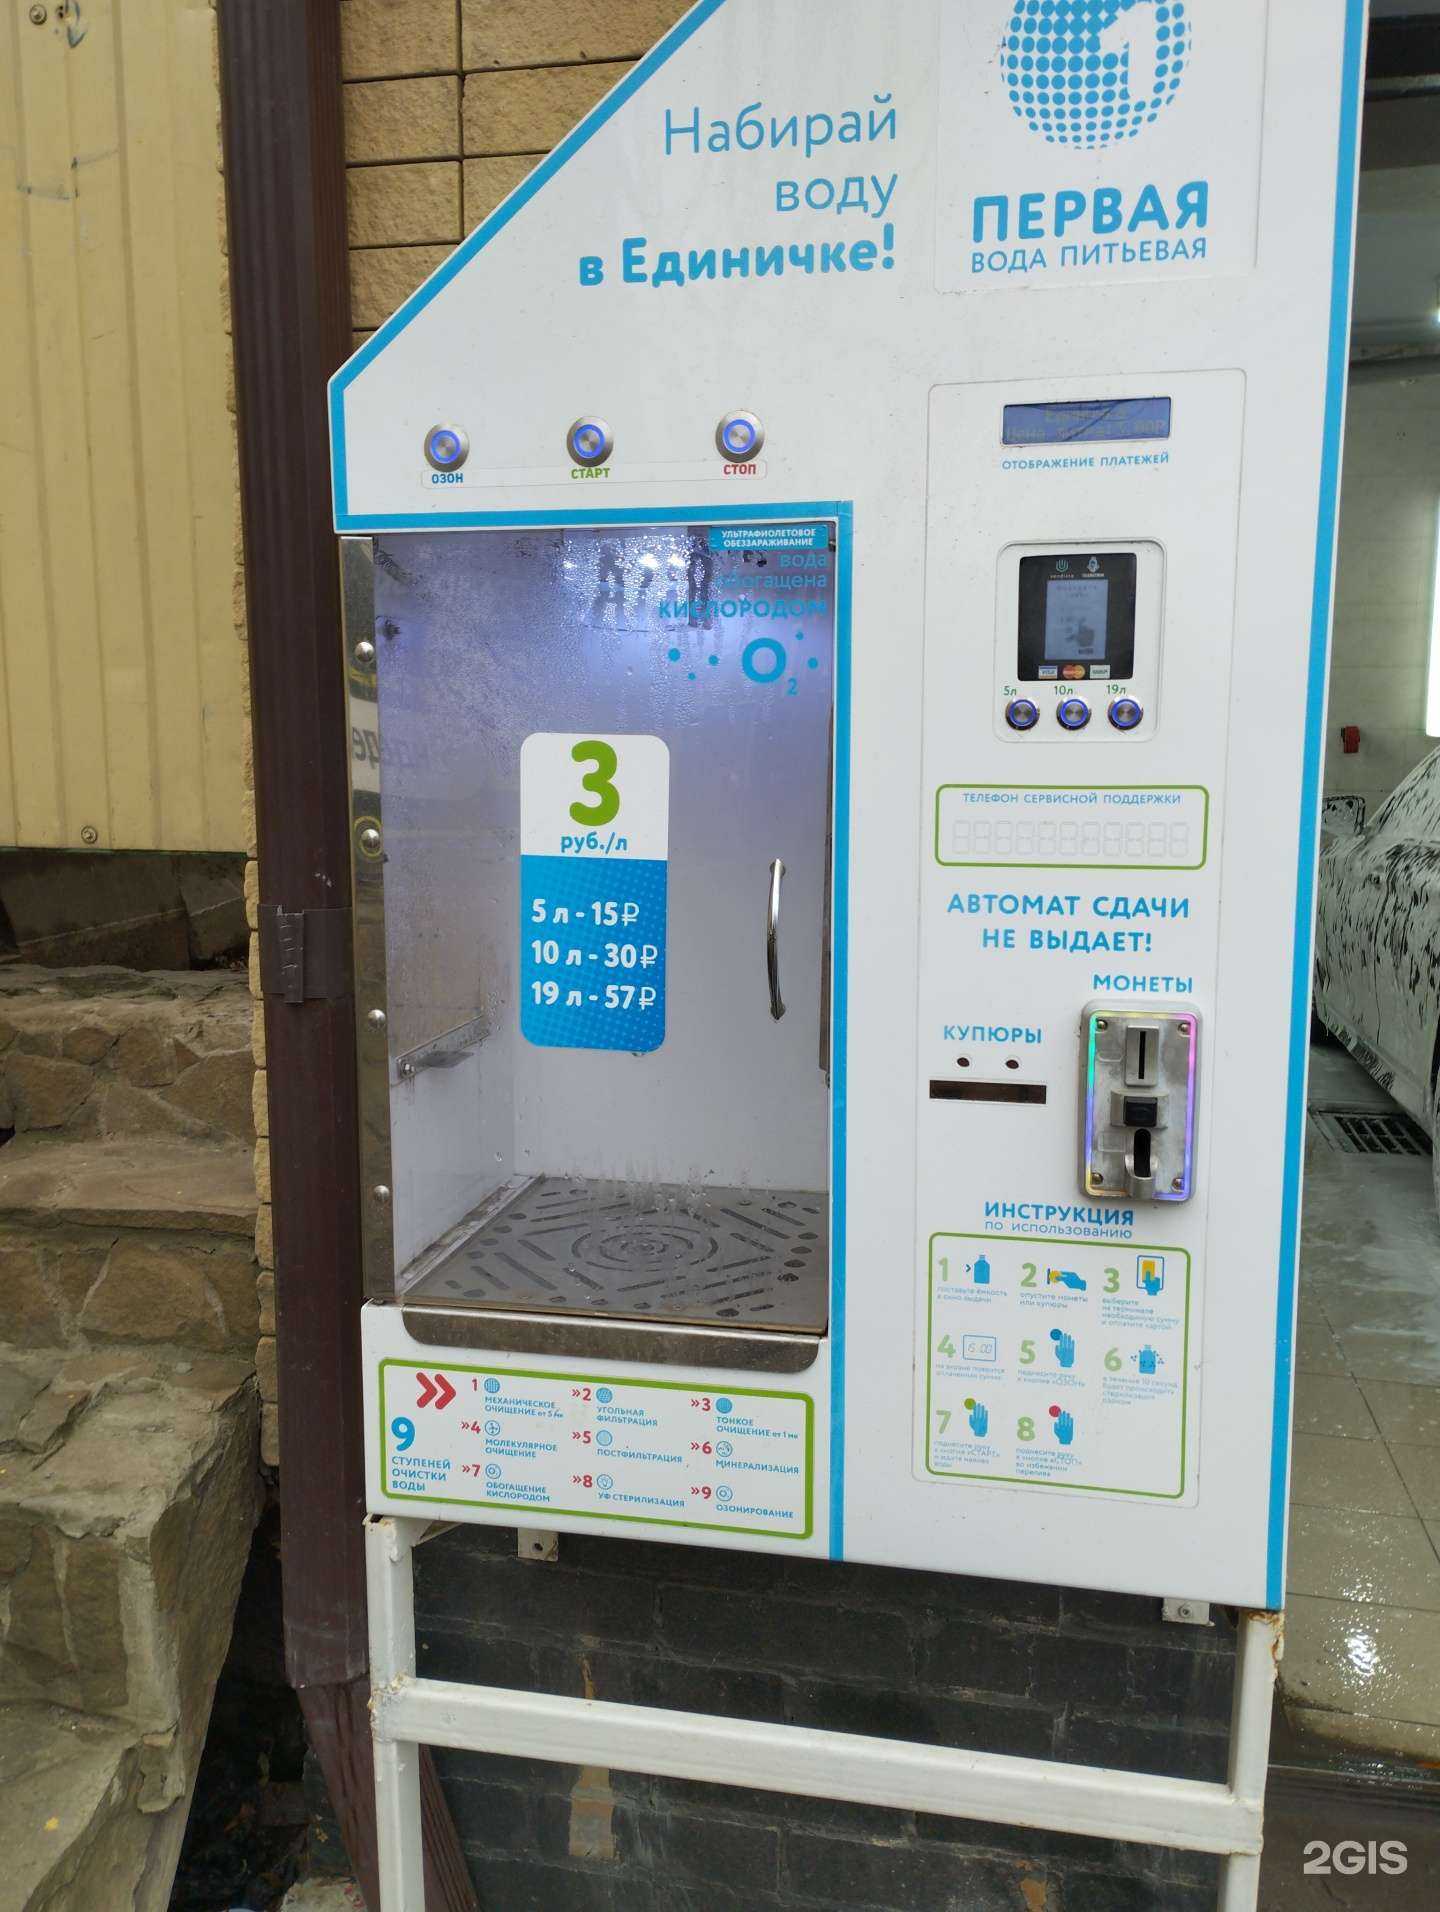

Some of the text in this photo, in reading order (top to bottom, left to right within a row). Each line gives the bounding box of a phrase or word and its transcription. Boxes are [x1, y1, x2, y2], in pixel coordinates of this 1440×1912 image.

[664, 93, 897, 158] Набирай
[776, 171, 898, 217] воду
[972, 181, 1210, 243] ПЕРВАЯ
[579, 224, 895, 288] в Единичке!
[971, 237, 1207, 275] ВОДА ПИТЬЕВАЯ
[1002, 452, 1169, 470] ОТОБРАЖЕНИЕ ПЛАТЕЖЕЙ
[570, 467, 611, 480] СТАРТ
[723, 463, 757, 476] СТОП
[431, 473, 464, 485] ОЗОН
[721, 528, 816, 539] УЛЬТРАФИОЛЕТОВОЕ
[723, 538, 813, 548] ОБЕЗЗАРАЖИВАНИЕ
[779, 554, 828, 570] вода
[1003, 686, 1017, 696] 5л
[1053, 685, 1074, 696] 10л
[1106, 684, 1127, 695] 19л
[569, 740, 620, 827] 3
[963, 792, 1181, 806] ТЕЛЕФОН СЕРВИСНОЙ ПОДДЕРЖКИ
[561, 831, 628, 854] руб./л
[532, 899, 546, 923] 5
[553, 908, 569, 923] л
[947, 893, 1189, 920] АВТОМАТ СДАЧИ
[982, 928, 1152, 953] НЕ ВЫДАЕТ!
[531, 940, 560, 965] 10
[566, 950, 582, 966] л
[1093, 974, 1193, 993] МОНЕТЫ
[531, 981, 560, 1005] 19
[566, 990, 582, 1006] л
[944, 1025, 1042, 1044] КУПЮРЫ
[985, 1201, 1134, 1226] ИНСТРУКЦИЯ
[938, 1257, 949, 1281] 1
[1020, 1262, 1037, 1288] 2
[1103, 1267, 1120, 1293] 3
[937, 1334, 956, 1358] 4
[1019, 1340, 1036, 1364] 5
[1104, 1347, 1122, 1371] 6
[471, 1379, 478, 1392] 1
[582, 1388, 592, 1401] 2
[485, 1396, 555, 1408] МЕХАНИЧЕСКОЕ
[701, 1397, 711, 1411] 3
[485, 1405, 537, 1416] ОЧИЩЕНИЕ
[596, 1406, 645, 1417] УГОЛЬНАЯ
[470, 1421, 482, 1434] 4
[596, 1415, 658, 1427] ФИЛЬТРАЦИЯ
[716, 1416, 753, 1426] ТОНКОЕ
[936, 1410, 952, 1434] 7
[391, 1416, 416, 1452] 9
[716, 1425, 770, 1437] ОЧИЩЕНИЕ
[1017, 1416, 1036, 1441] 8
[582, 1431, 592, 1444] 5
[485, 1439, 558, 1452] МОЛЕКУЛЯРНОЕ
[485, 1447, 537, 1458] ОЧИЩЕНИЕ
[702, 1441, 712, 1455] 6
[392, 1455, 451, 1469] СТУПЕНЕЙ
[597, 1448, 683, 1464] ПОСТФИЛЬТРАЦИЯ
[471, 1464, 481, 1477] 7
[716, 1459, 799, 1475] МИНЕРАЛИЗАЦИЯ
[392, 1468, 447, 1481] ОЧИСТКИ
[582, 1474, 593, 1488] 8
[392, 1480, 426, 1492] ВОДЫ
[486, 1482, 547, 1494] ОБОГАЩЕНИЕ
[701, 1486, 712, 1500] 9
[486, 1490, 550, 1502] КИСЛОРОДОМ
[612, 1494, 685, 1508] СТЕРИЛИЗАЦИЯ
[716, 1504, 794, 1519] ОЗОНИРОВАНИЕ
